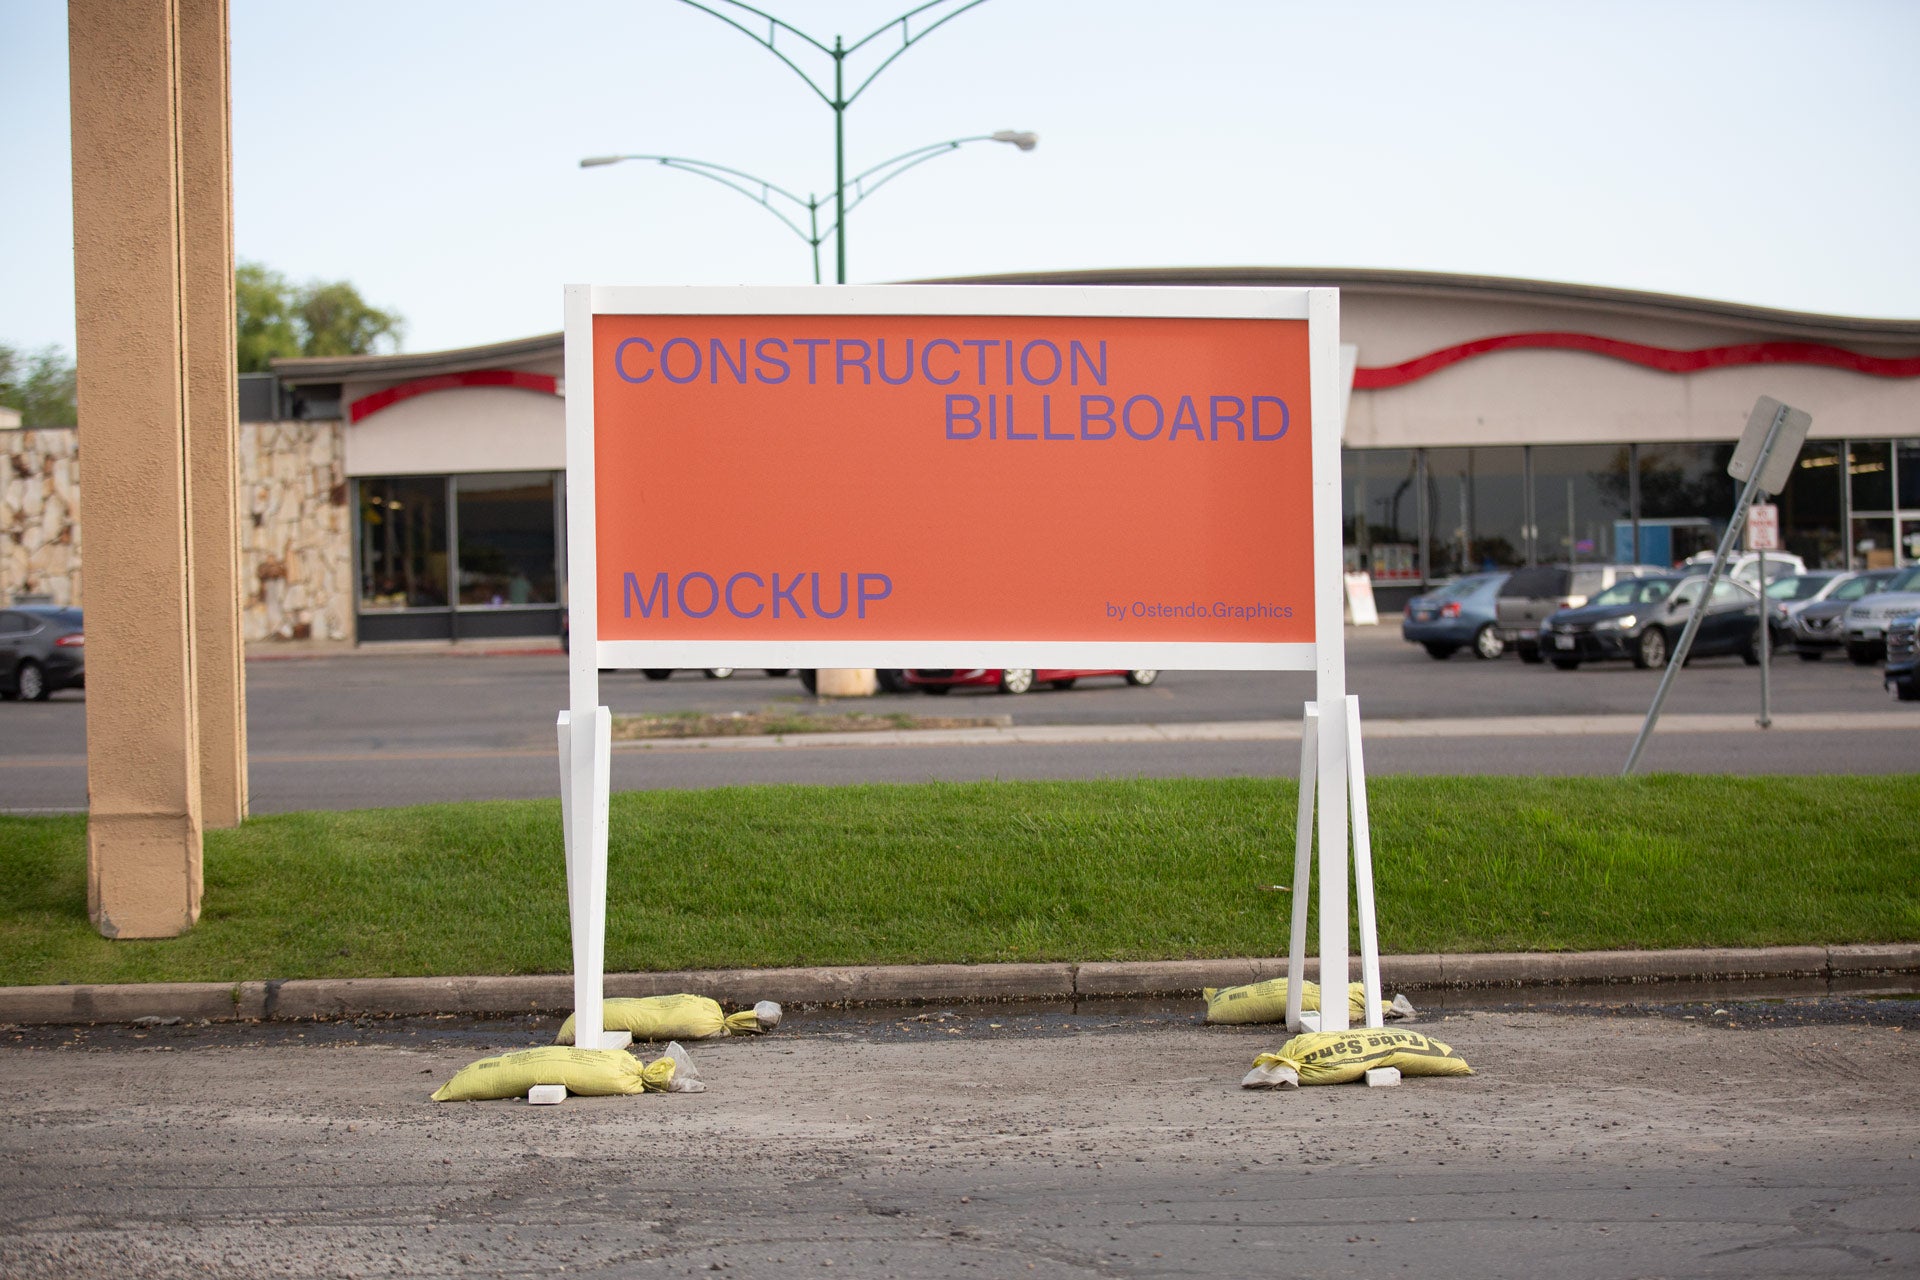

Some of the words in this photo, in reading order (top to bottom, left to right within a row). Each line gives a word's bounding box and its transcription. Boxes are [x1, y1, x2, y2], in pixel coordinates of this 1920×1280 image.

[615, 337, 1107, 386] CONSTRUCTION
[945, 394, 1290, 441] BILLBOARD
[623, 571, 893, 619] MOCKUP
[1106, 602, 1127, 621] by
[1131, 601, 1293, 621] Ostendo.Graphics
[1304, 1039, 1363, 1064] Sand
[1368, 1034, 1424, 1047] Tube
